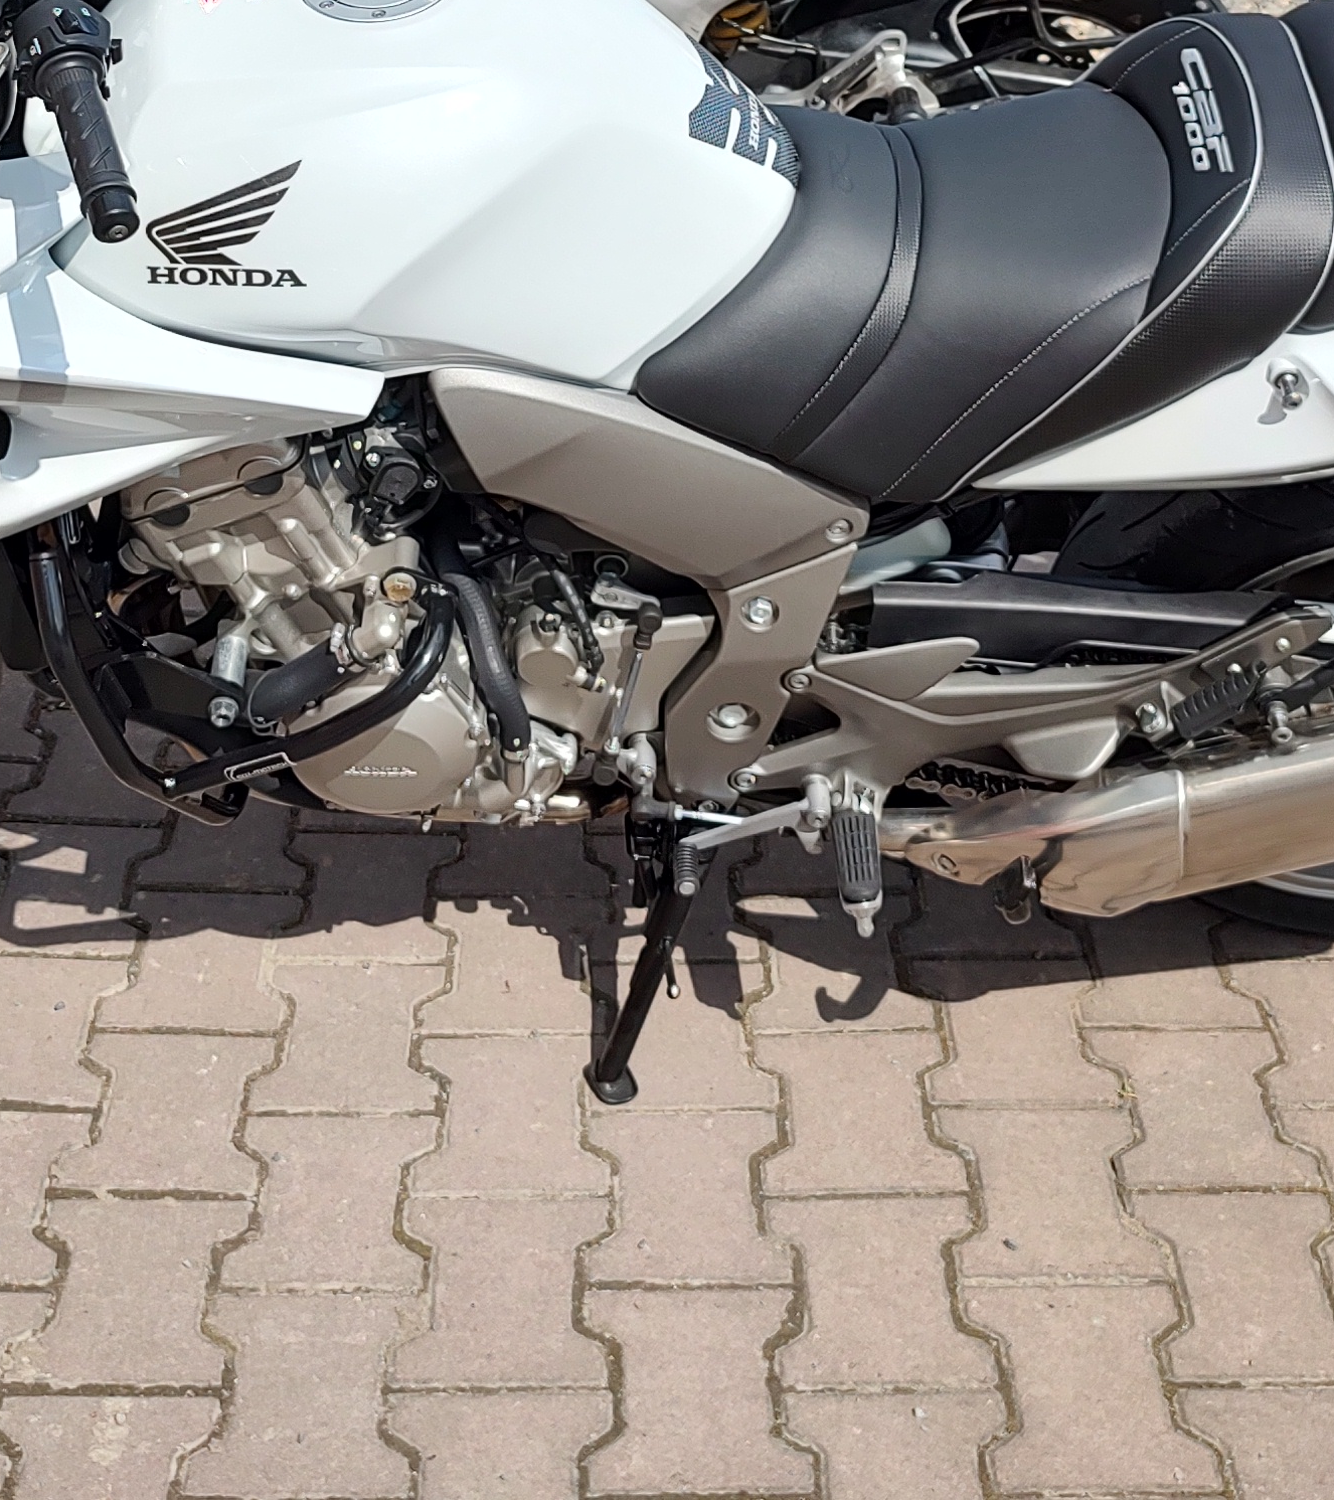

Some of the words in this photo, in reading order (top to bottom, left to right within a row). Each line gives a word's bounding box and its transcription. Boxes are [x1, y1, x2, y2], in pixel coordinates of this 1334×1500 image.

[1171, 81, 1211, 171] 1000
[1180, 47, 1235, 173] CBF
[146, 266, 308, 288] HONDA
